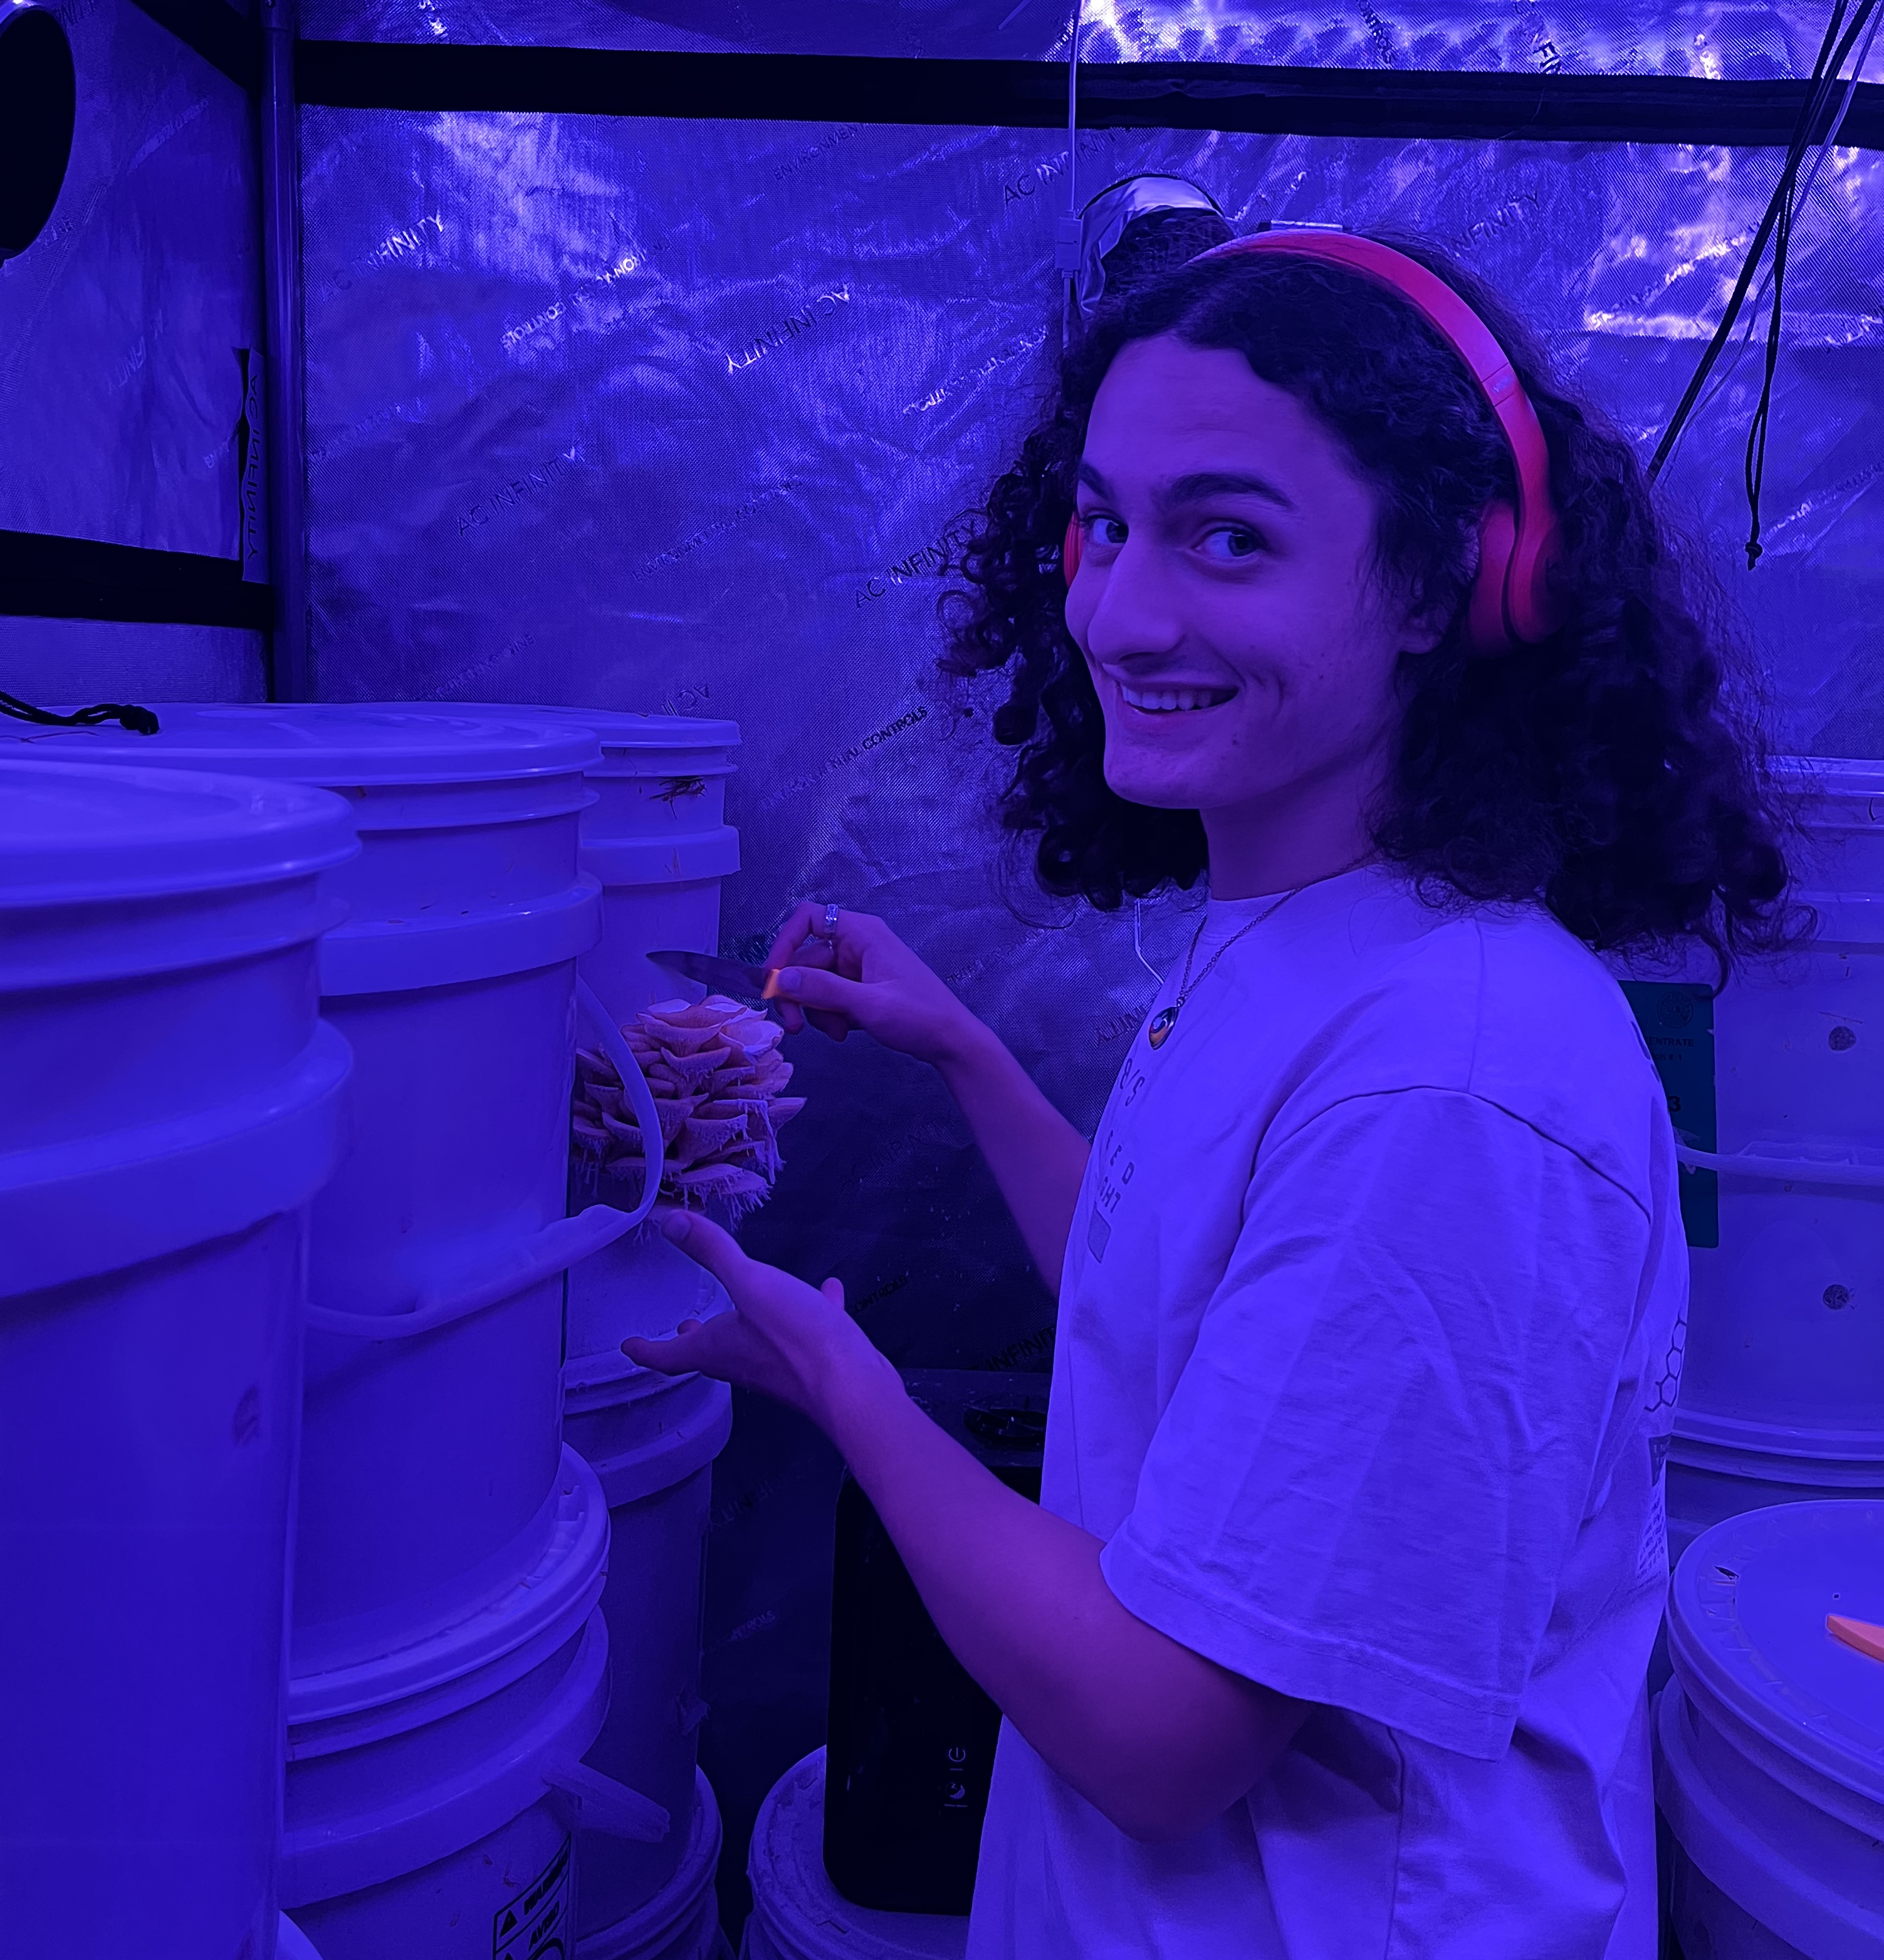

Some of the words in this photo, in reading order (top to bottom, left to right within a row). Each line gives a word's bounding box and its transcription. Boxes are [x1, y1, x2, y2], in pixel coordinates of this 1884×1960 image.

[1004, 175, 1035, 206] AC
[817, 283, 850, 316] AC
[725, 305, 817, 376] INFINITY
[458, 504, 489, 536] AC
[489, 446, 580, 514] INFINITY
[856, 578, 886, 608] AC
[886, 520, 975, 577] INFINITY
[862, 706, 928, 750] CONTROLS
